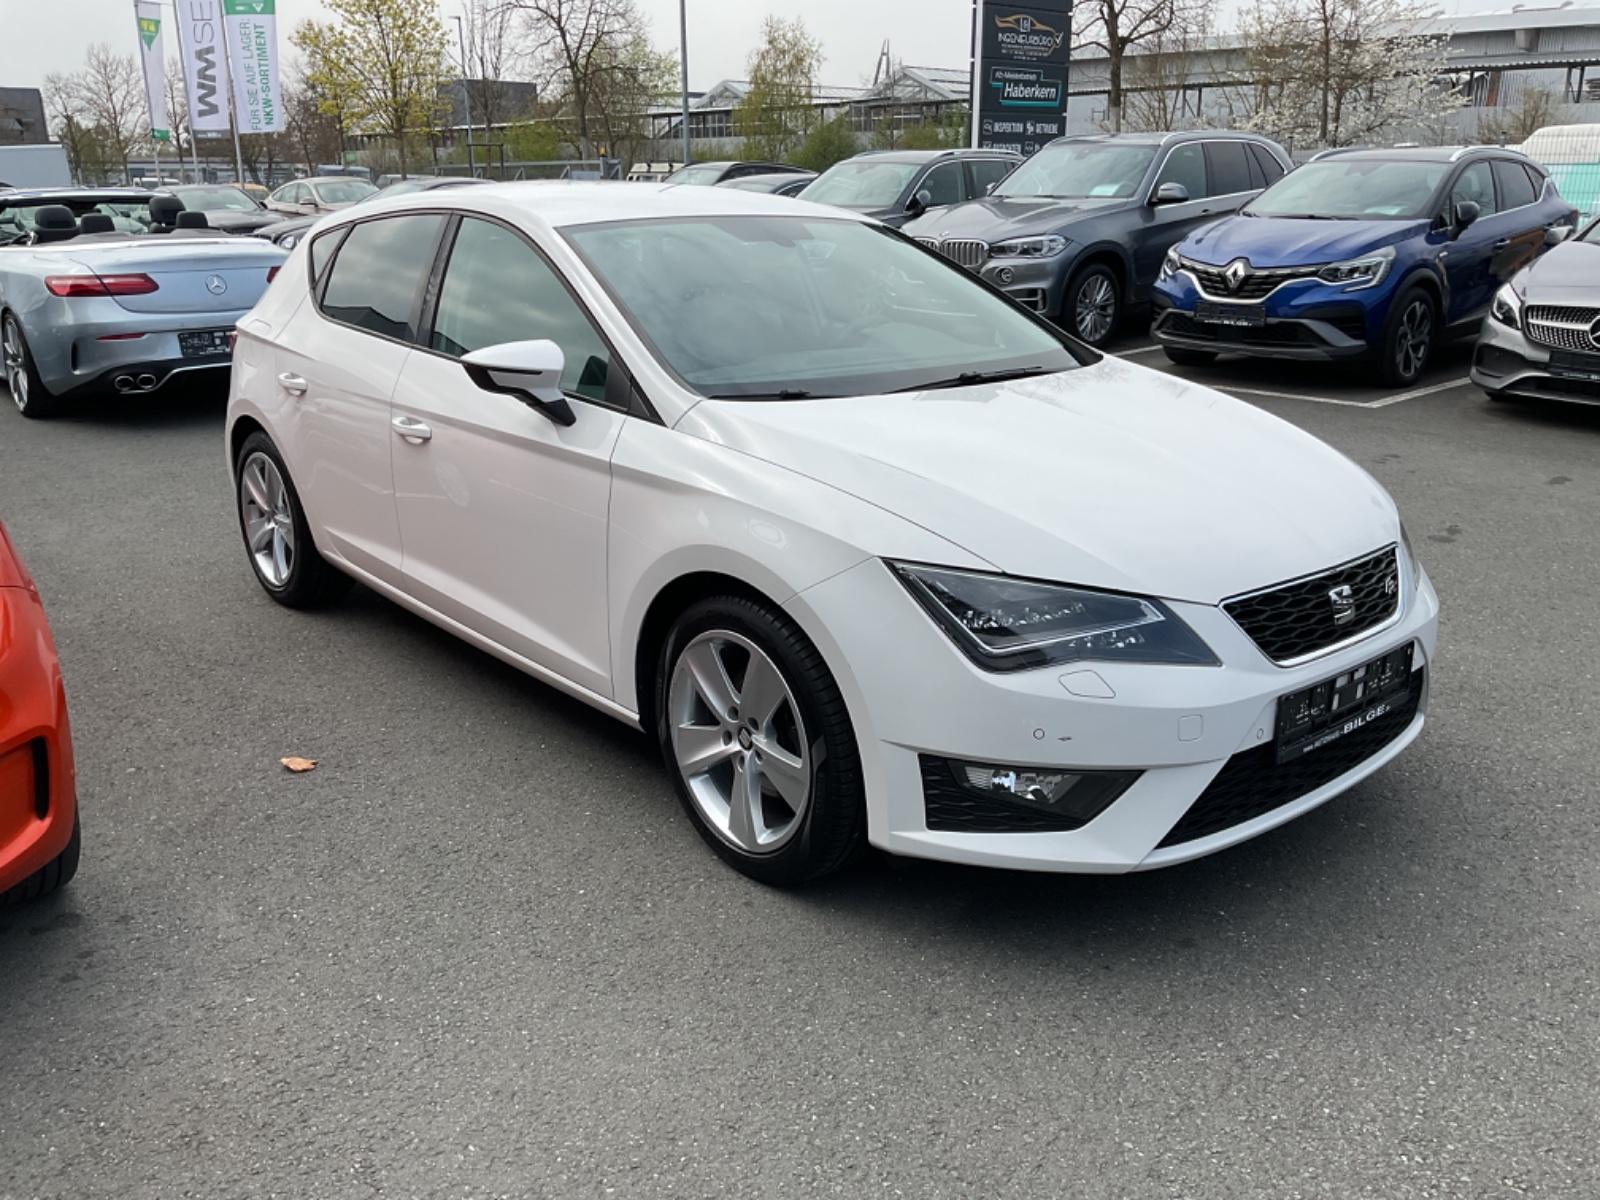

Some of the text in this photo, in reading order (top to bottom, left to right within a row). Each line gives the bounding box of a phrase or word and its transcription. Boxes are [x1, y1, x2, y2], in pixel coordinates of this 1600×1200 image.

[243, 63, 256, 85] AUF
[253, 23, 274, 126] NKW-SORTIMENT
[247, 89, 259, 106] SIE
[1004, 82, 1057, 99] Haberkern
[249, 109, 262, 131] FÜR
